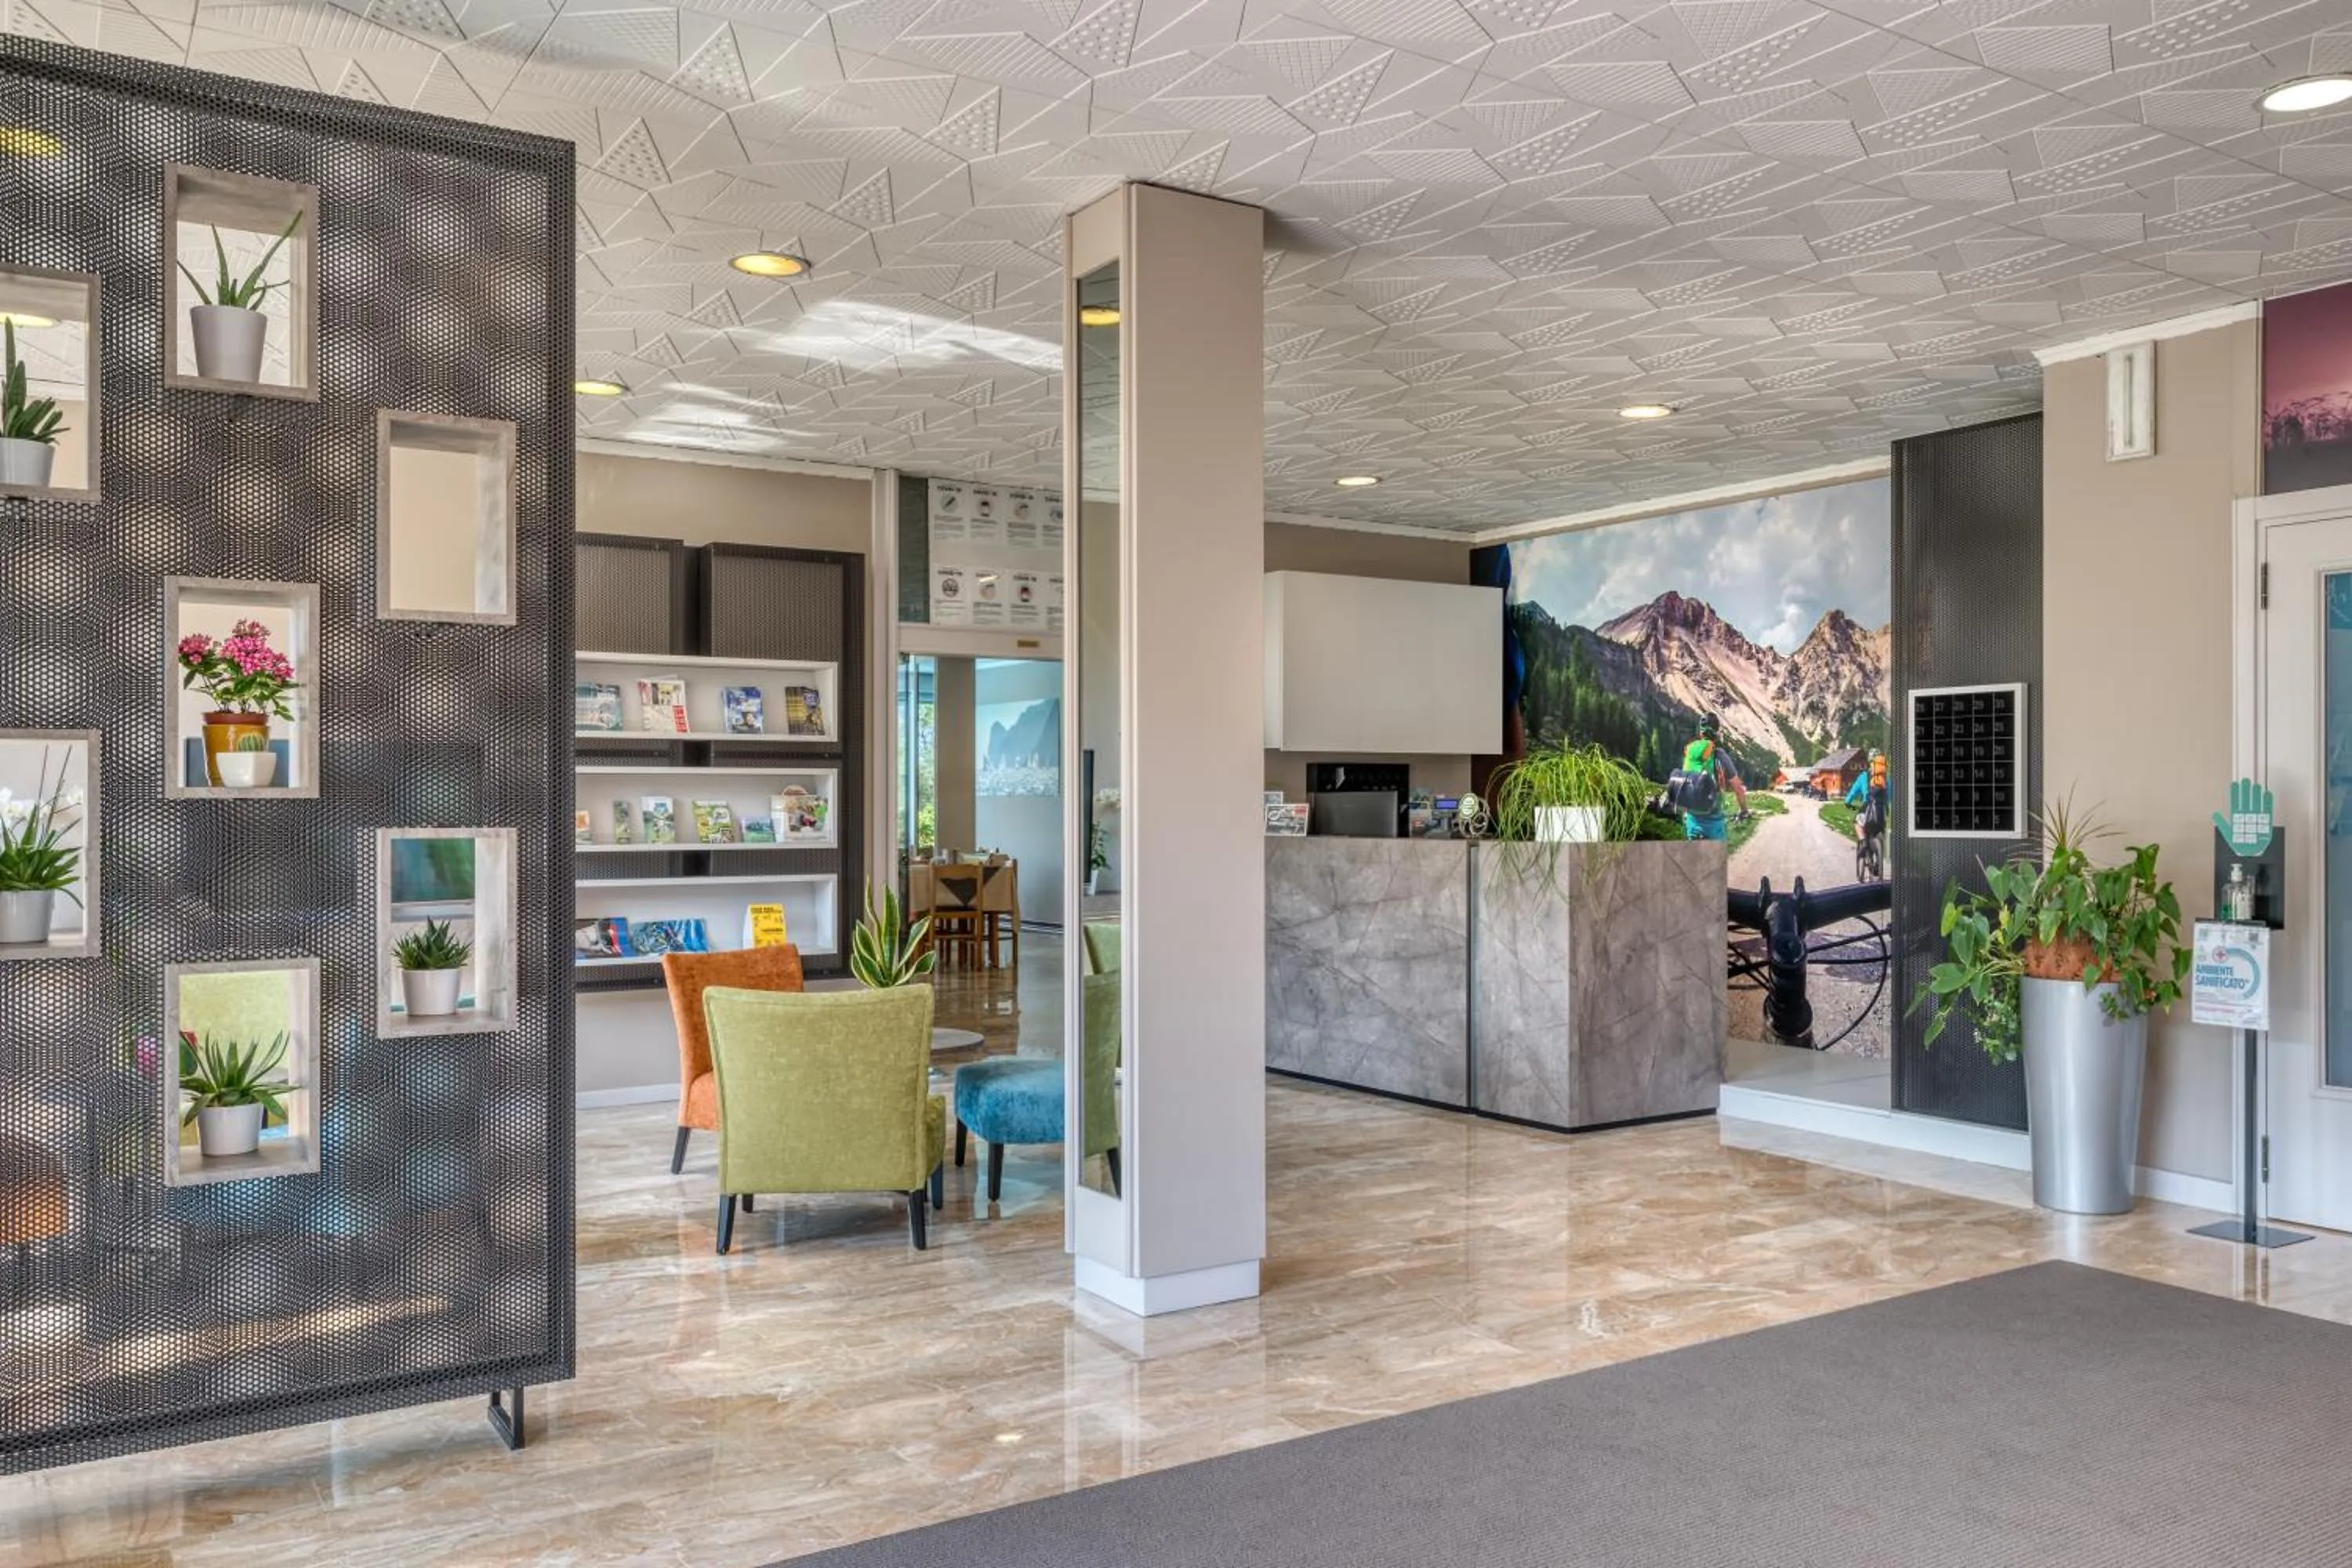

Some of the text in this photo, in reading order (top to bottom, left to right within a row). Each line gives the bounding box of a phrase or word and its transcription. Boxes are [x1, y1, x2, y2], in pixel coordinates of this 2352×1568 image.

[1975, 768, 1984, 778] 14
[1995, 768, 2004, 778] 15
[1995, 791, 2004, 801] 10
[2196, 964, 2234, 976] AMBIENTE
